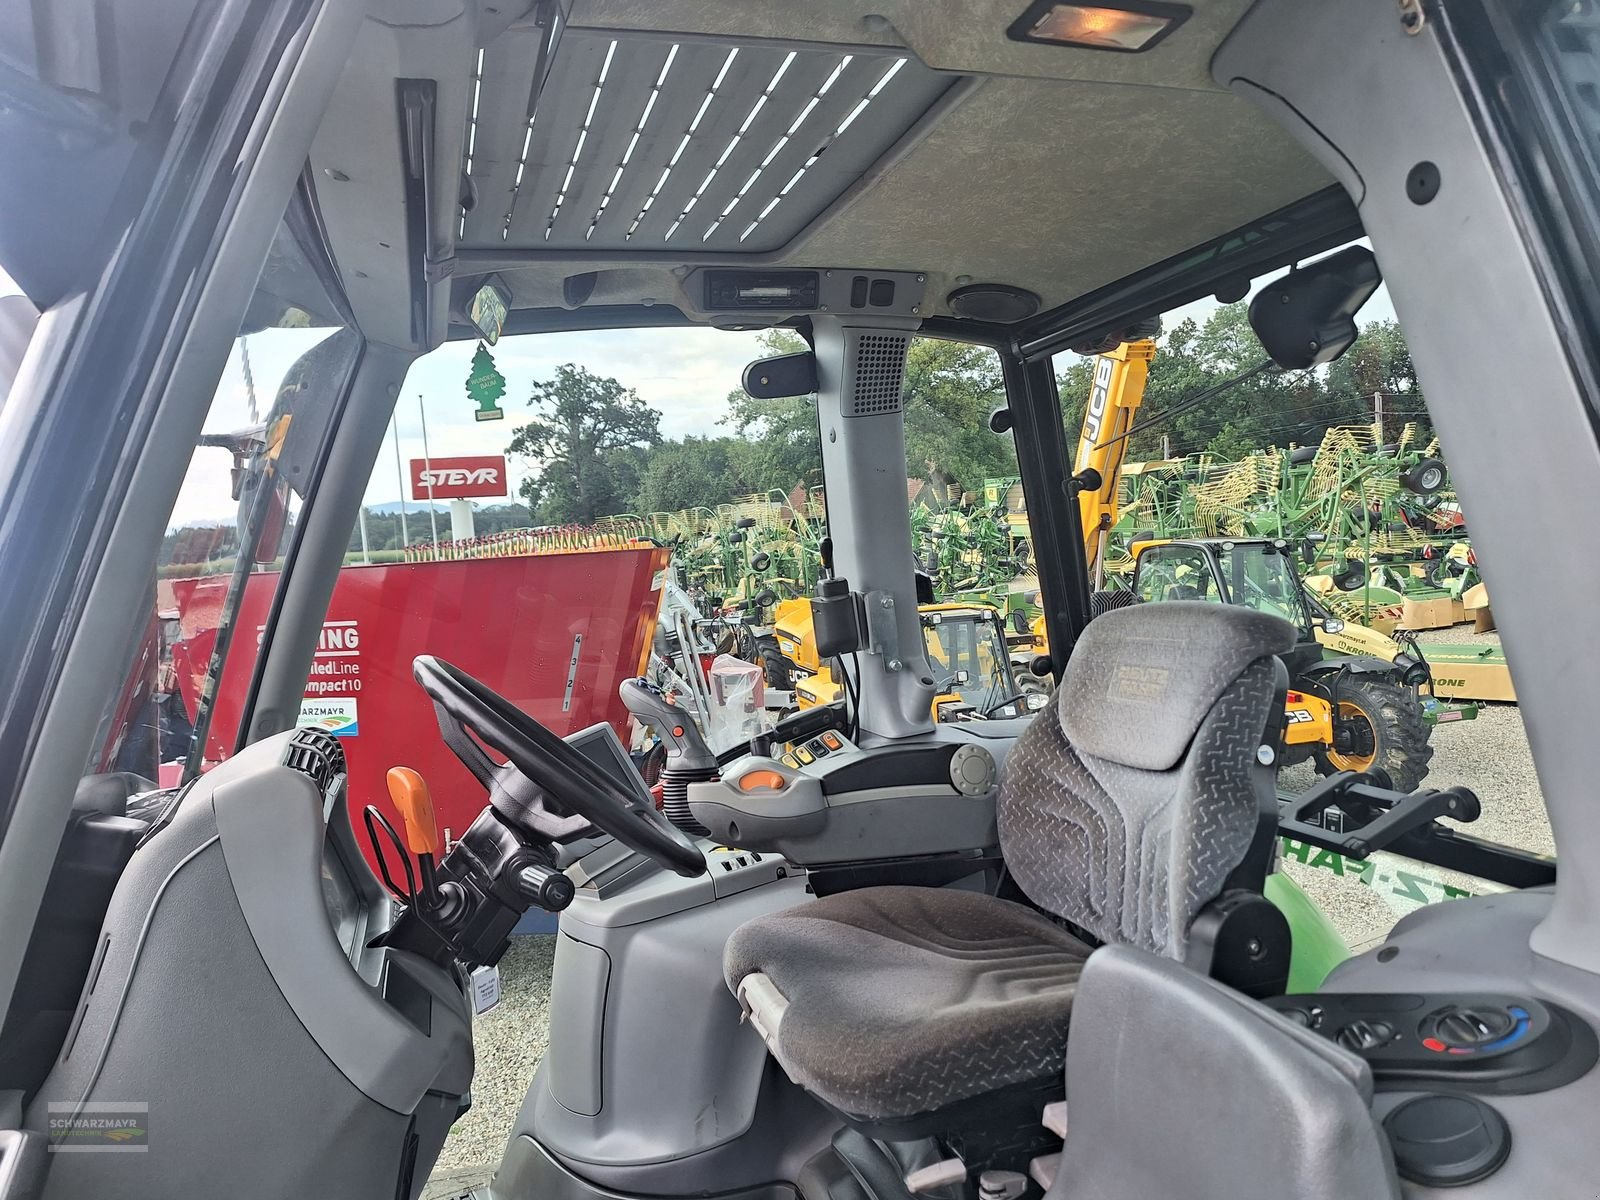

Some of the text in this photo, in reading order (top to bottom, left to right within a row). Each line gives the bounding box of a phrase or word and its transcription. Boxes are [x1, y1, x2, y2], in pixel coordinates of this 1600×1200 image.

[1086, 358, 1113, 442] JCB
[417, 468, 498, 487] STEYR
[575, 635, 581, 644] 4
[311, 660, 360, 674] iledLine
[571, 657, 577, 666] 3
[788, 668, 809, 682] JCB
[304, 679, 361, 695] mpact10
[567, 679, 573, 688] 2
[1431, 678, 1466, 687] RONE
[564, 701, 569, 709] 1
[302, 707, 345, 716] ARZMAYR
[1284, 709, 1314, 723] CB
